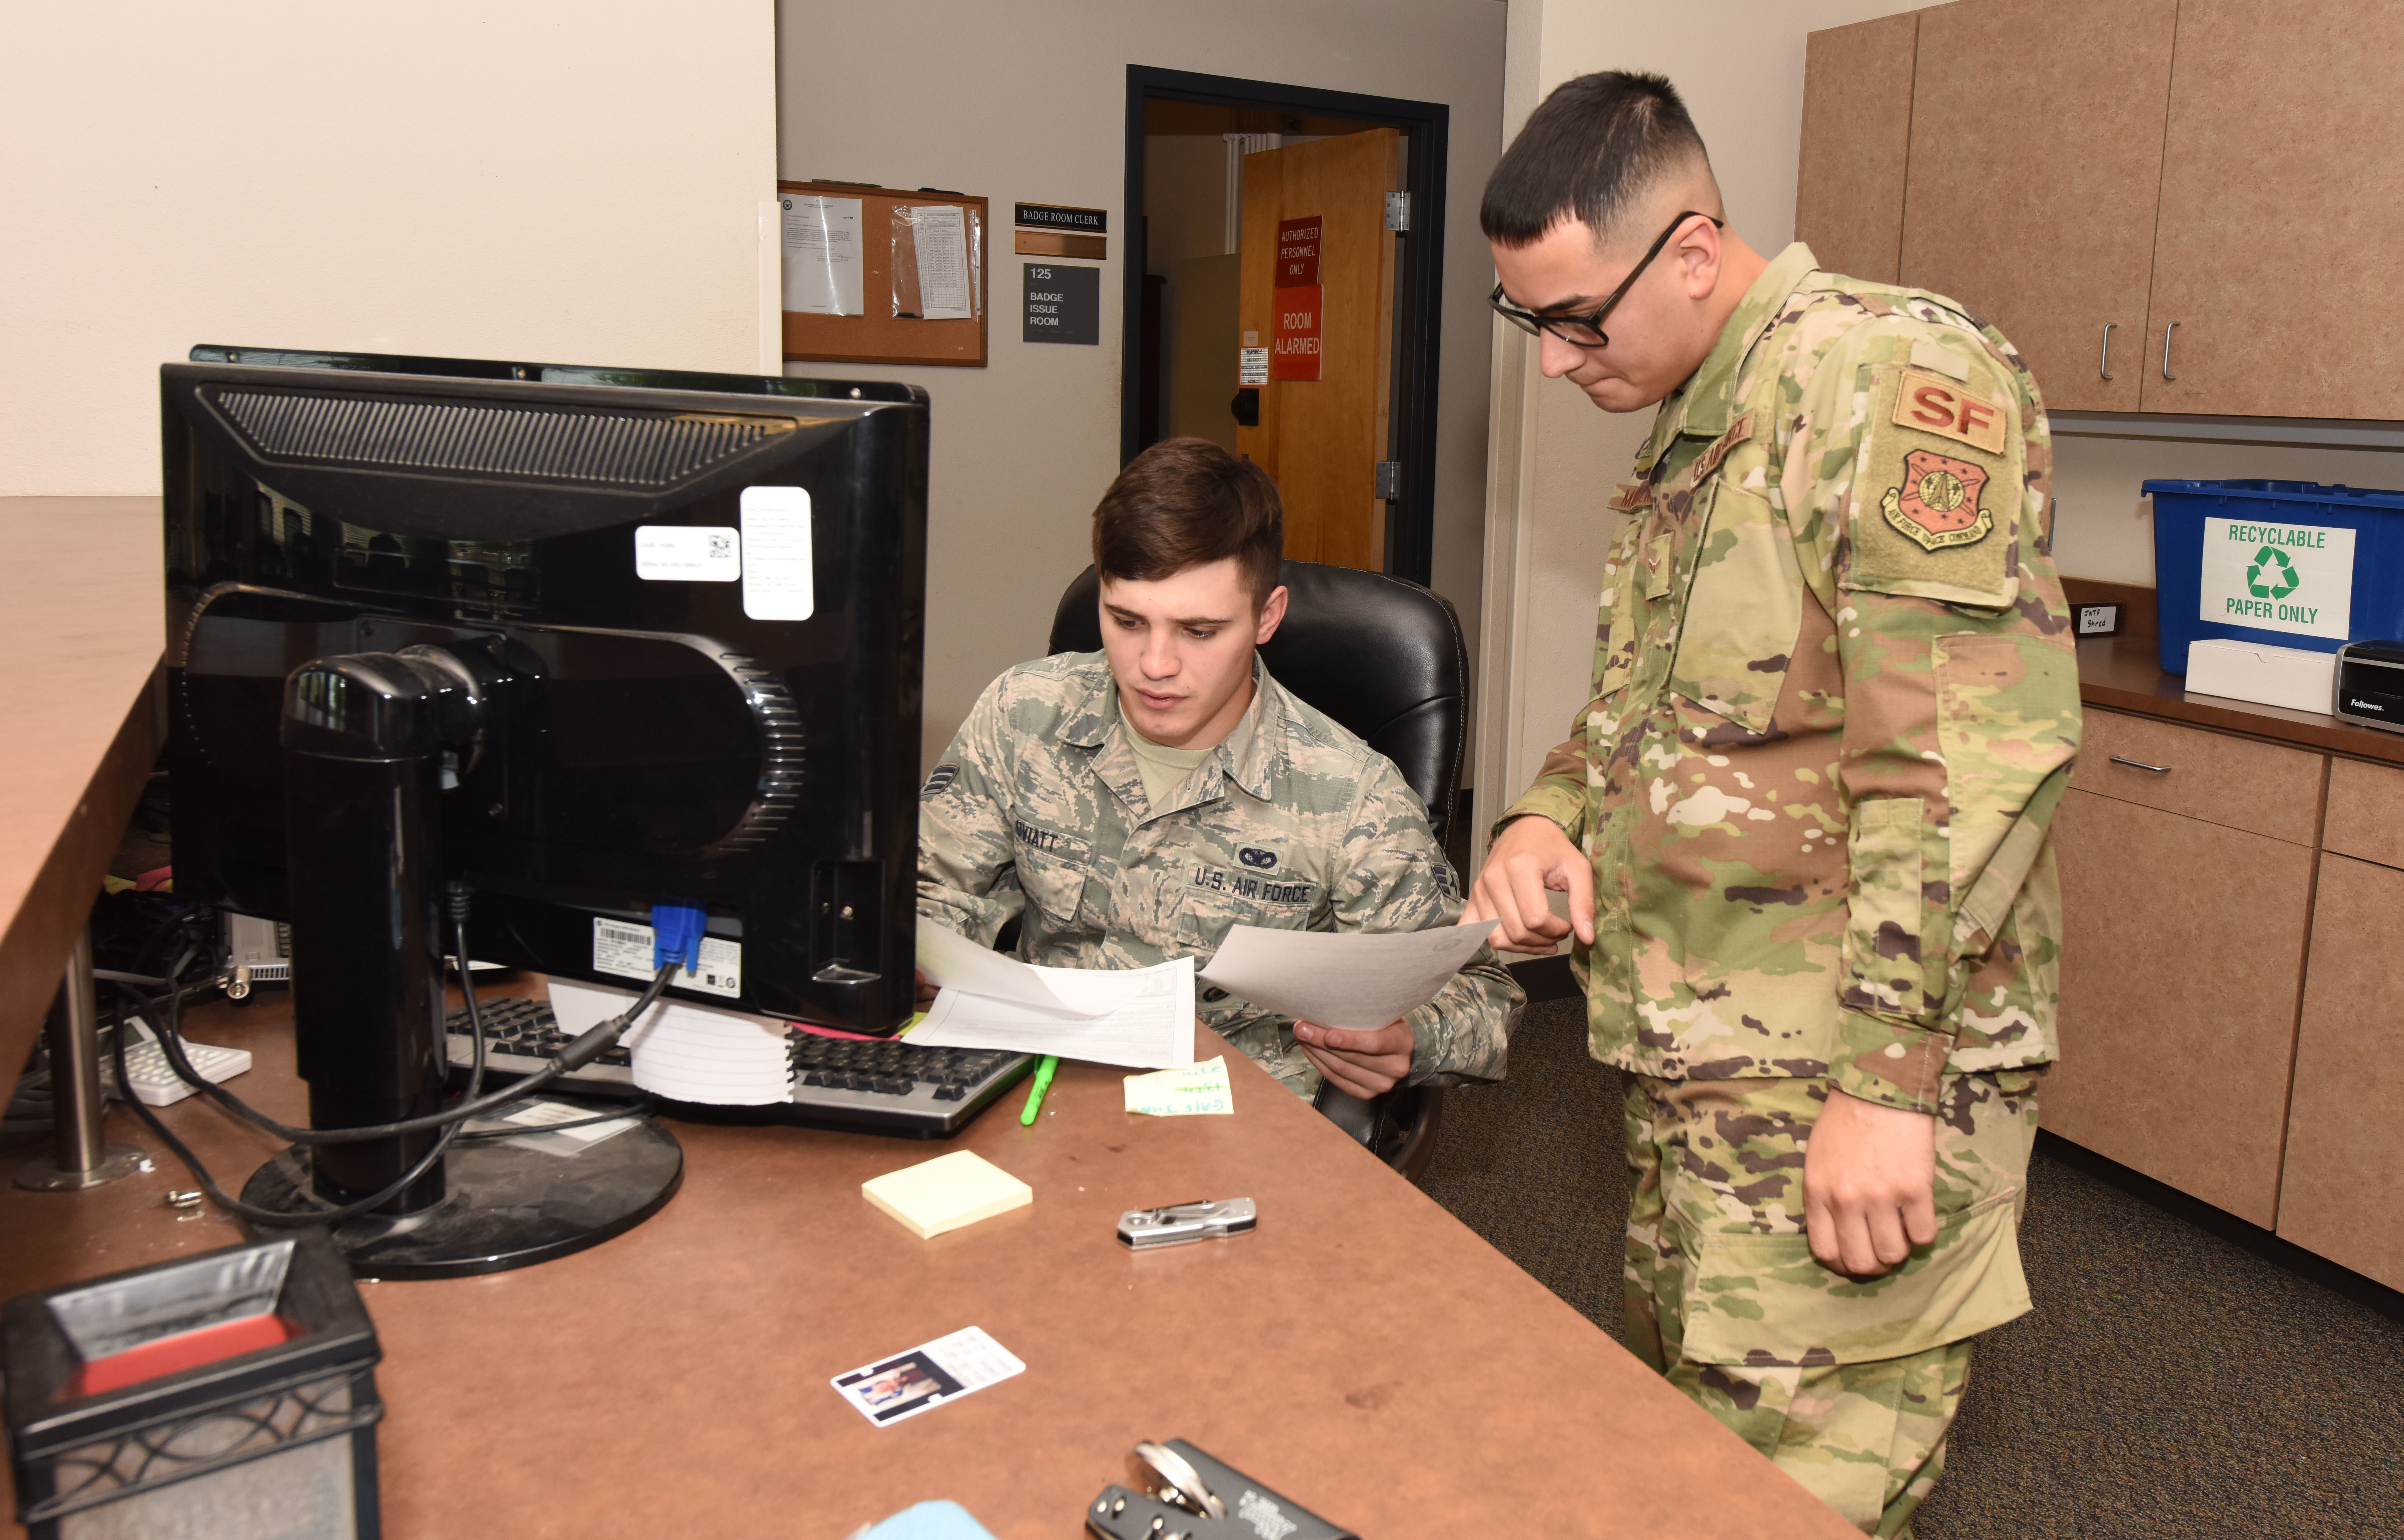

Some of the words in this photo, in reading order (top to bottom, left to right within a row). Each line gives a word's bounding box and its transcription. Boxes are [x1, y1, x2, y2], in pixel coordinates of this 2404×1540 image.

[1023, 210, 1049, 221] BADGE
[1051, 212, 1073, 223] ROOM
[1074, 214, 1099, 225] CLERK
[1281, 227, 1318, 242] AUTHORIZED
[1281, 245, 1316, 259] PERSONNEL
[1030, 268, 1051, 279] 125
[1290, 263, 1305, 275] ONLY
[1030, 292, 1063, 302] BADGE
[1030, 304, 1058, 314] ISSUE
[1030, 317, 1059, 326] ROOM
[1284, 312, 1312, 329] ROOM
[1275, 337, 1320, 354] ALARMED
[1910, 386, 1994, 435] SF
[1888, 509, 1900, 520] AIR
[1896, 518, 1920, 536] FORCE
[1921, 533, 1944, 544] SPACE
[1949, 526, 1981, 542] COMMAND
[2228, 524, 2326, 549] RECYCLABLE
[2227, 598, 2272, 619] PAPER
[2278, 604, 2318, 624] ONLY
[2087, 617, 2106, 628] Shred
[2350, 699, 2383, 711] Fellowes
[1195, 867, 1226, 891] U.S.
[1232, 876, 1259, 898] AIR
[1261, 883, 1310, 903] FORCE
